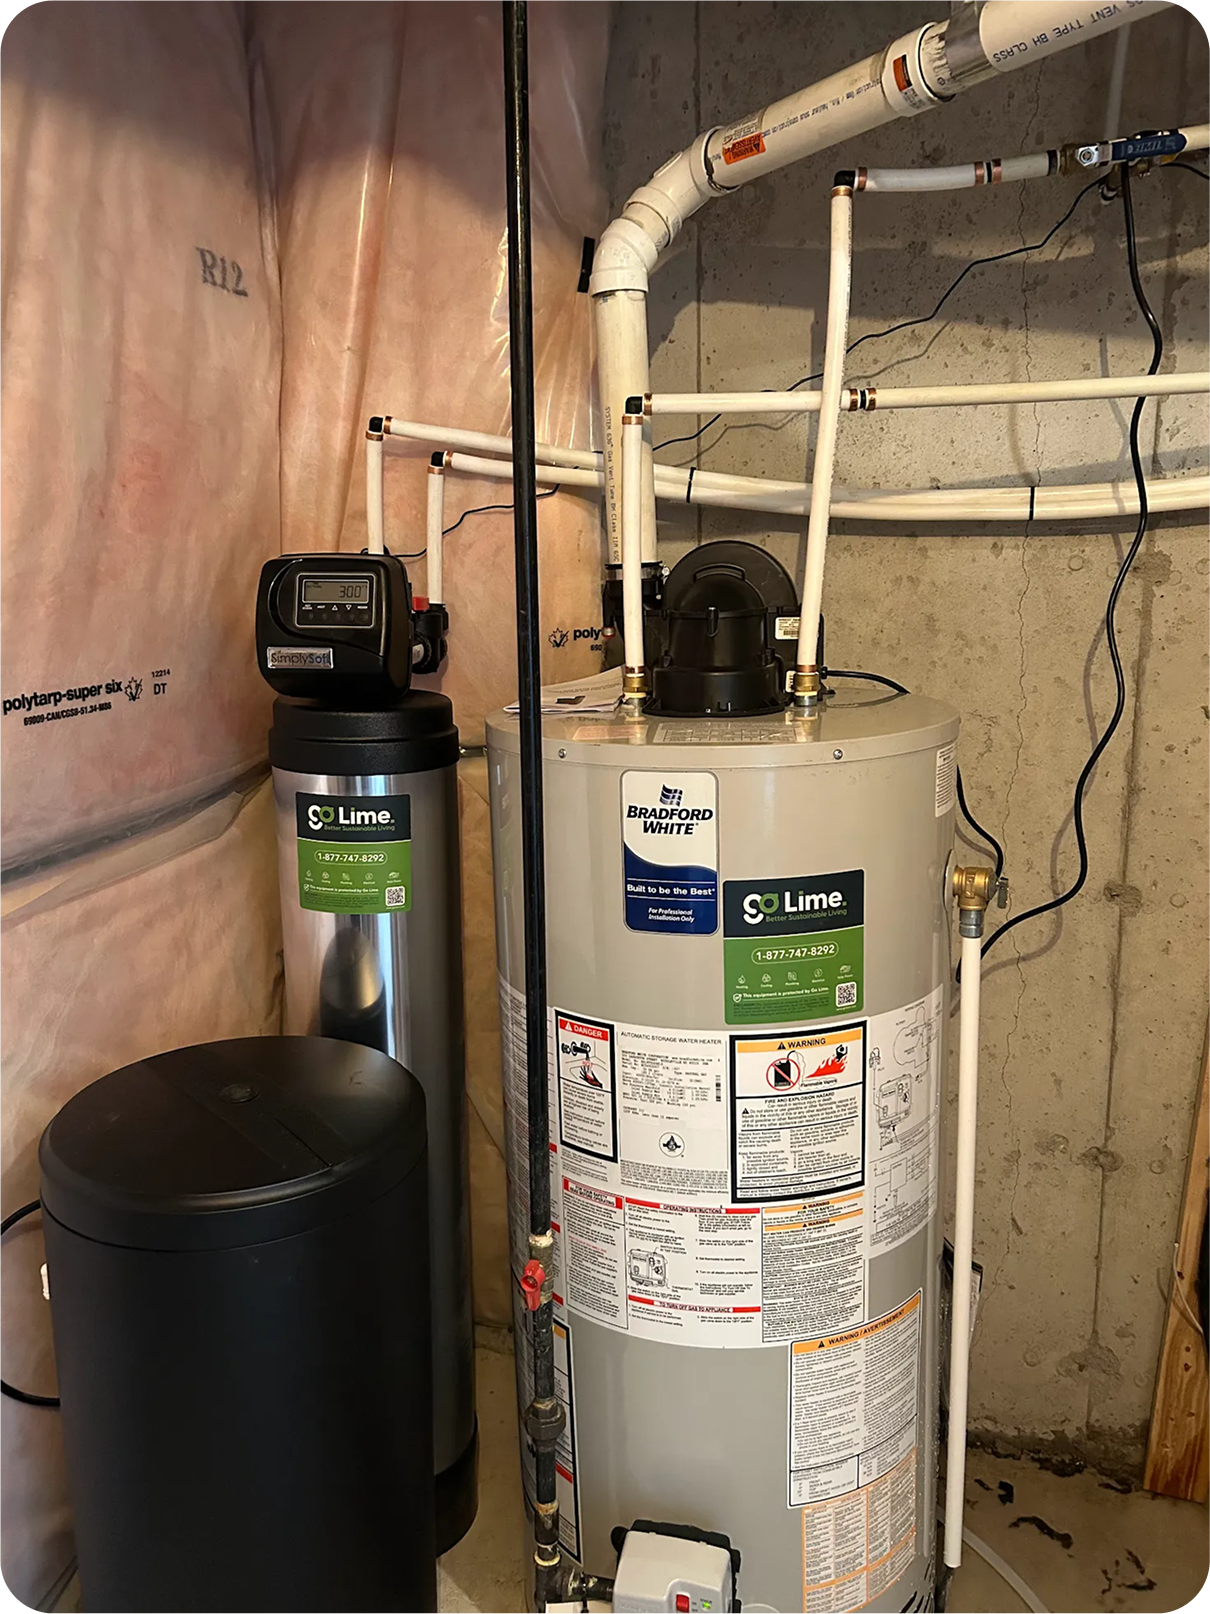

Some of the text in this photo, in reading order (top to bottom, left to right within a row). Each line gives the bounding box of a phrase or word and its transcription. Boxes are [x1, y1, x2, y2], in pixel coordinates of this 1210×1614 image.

[992, 4, 1122, 63] VENT TYPE BH CLASS
[194, 245, 248, 298] R12
[270, 650, 330, 666] SimplySoft
[152, 669, 170, 678] 12214
[154, 682, 168, 695] DT
[2, 679, 123, 715] polytarp-super six
[626, 805, 714, 821] BRADFORD
[642, 820, 694, 835] WHITE
[318, 852, 384, 862] 1-877-747-8292
[627, 884, 646, 894] Built
[659, 886, 670, 894] be
[673, 886, 688, 896] the
[766, 908, 848, 922] Better Sustainable Living
[756, 944, 835, 960] 1-877-747-8292
[574, 1024, 602, 1038] DANGER
[620, 1031, 650, 1041] AUTOMATIC
[788, 1038, 826, 1049] WARNING
[800, 1080, 823, 1088] Flammable
[828, 1331, 859, 1345] WARNING
[864, 1309, 905, 1335] AVERTISSEMENT
